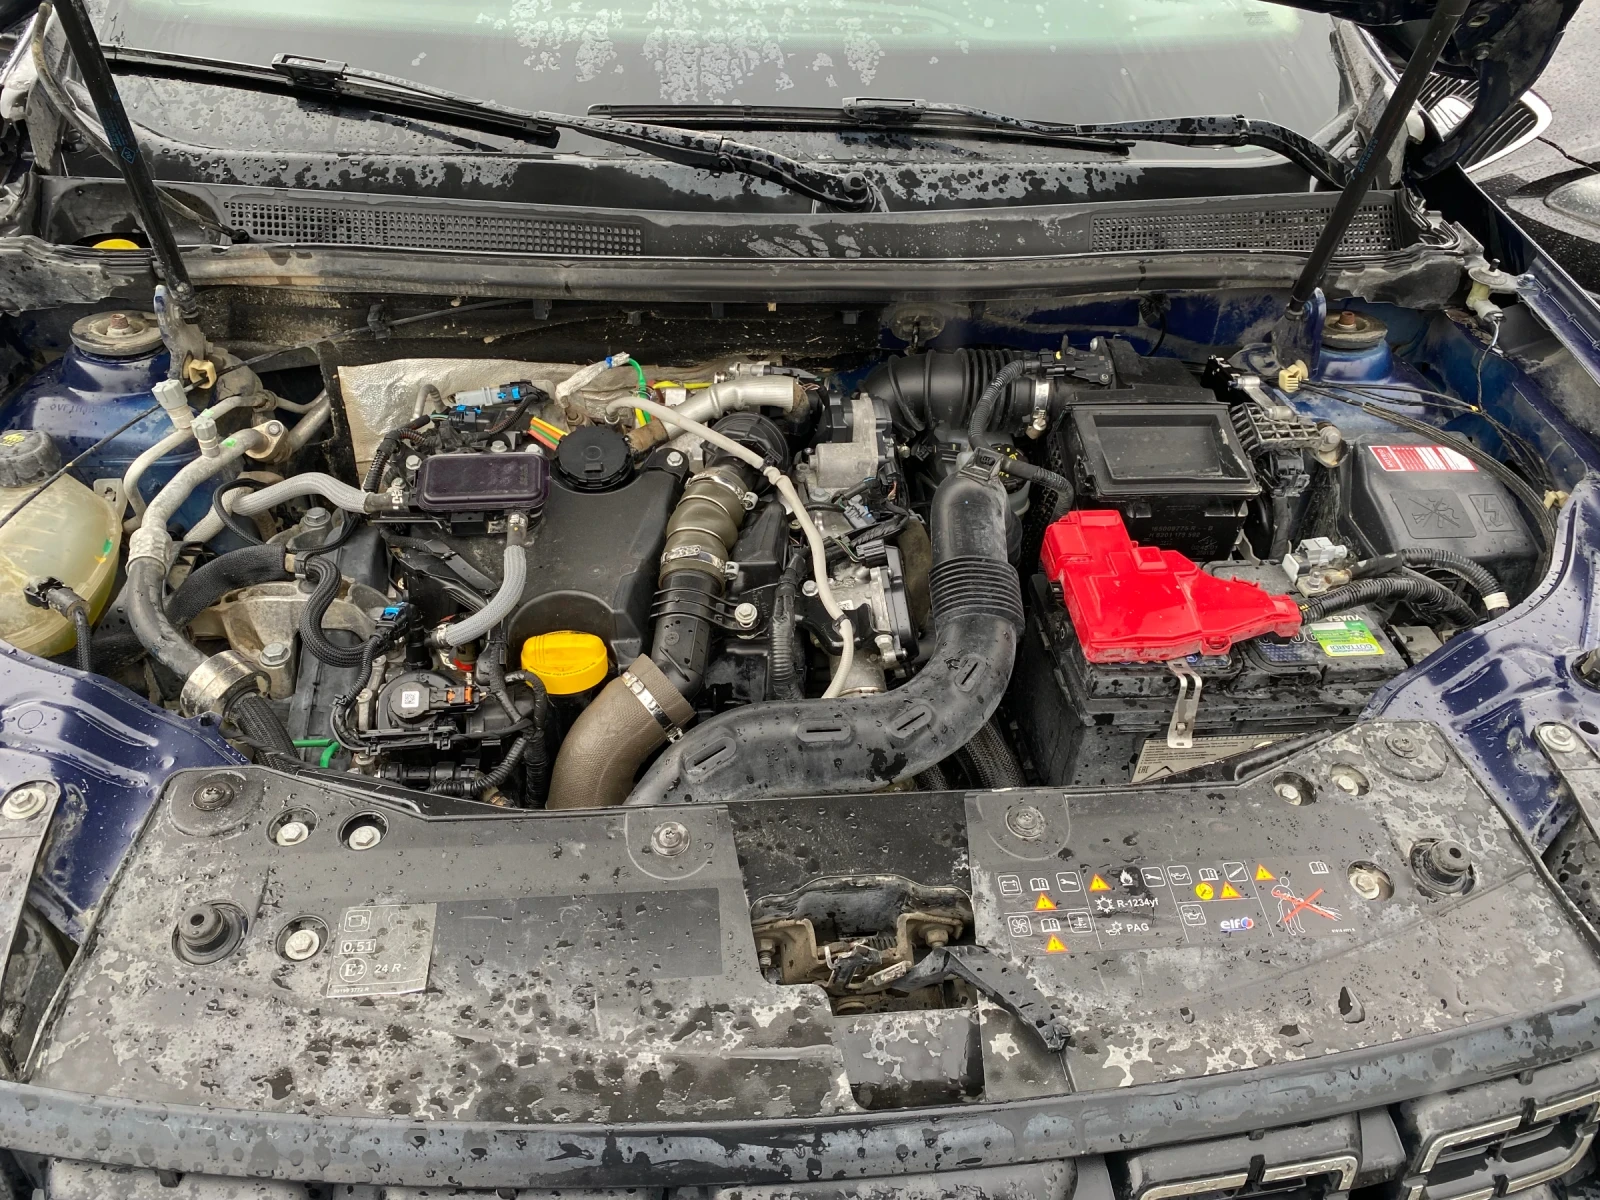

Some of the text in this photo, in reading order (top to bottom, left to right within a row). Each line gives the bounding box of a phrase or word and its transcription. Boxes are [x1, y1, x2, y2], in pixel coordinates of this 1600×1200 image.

[1326, 614, 1363, 622] YUASA
[1117, 897, 1159, 908] R-1234yf
[1126, 922, 1150, 932] PAG
[1220, 918, 1241, 929] elf
[374, 963, 389, 974] 24
